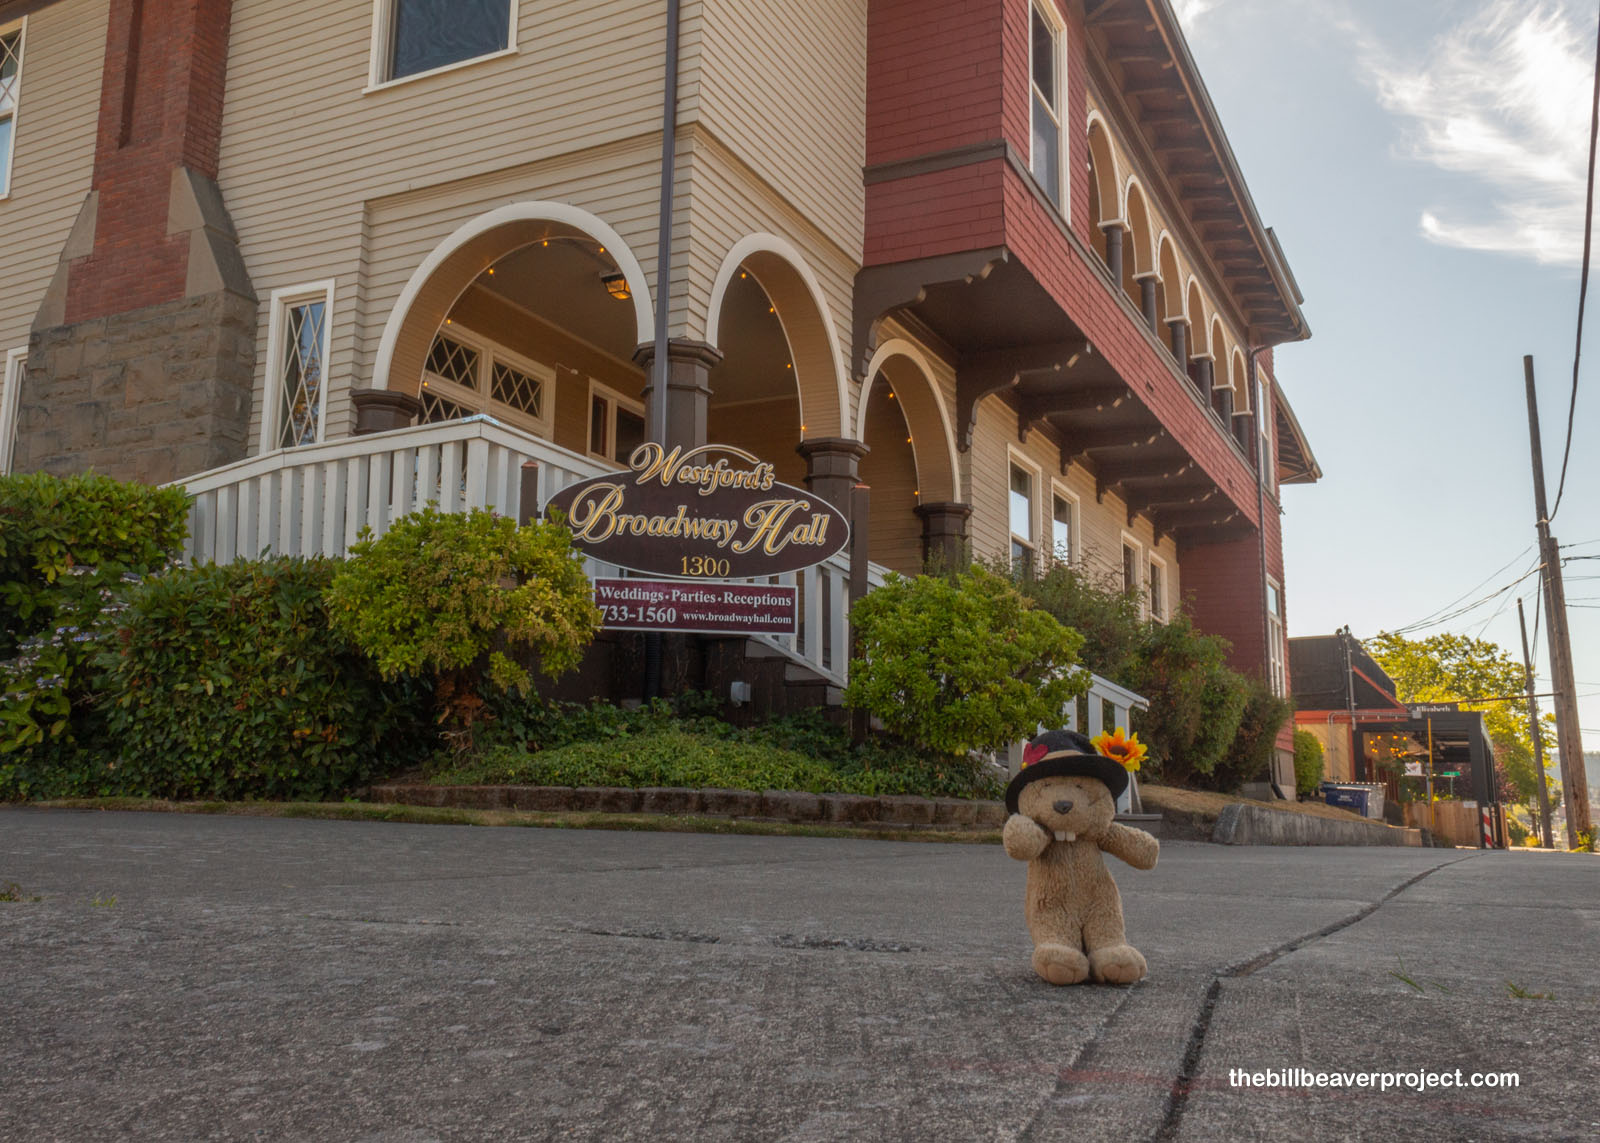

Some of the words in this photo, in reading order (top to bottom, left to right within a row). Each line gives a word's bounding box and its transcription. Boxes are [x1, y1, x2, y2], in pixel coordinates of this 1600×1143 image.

[629, 442, 776, 496] Westford's
[569, 482, 739, 548] Broadway
[731, 499, 831, 556] Hall
[680, 556, 731, 577] 1300
[599, 586, 664, 603] Weddings
[671, 589, 716, 604] Parties
[723, 591, 792, 608] Receptions
[599, 604, 677, 624] 733-1560
[683, 612, 792, 625] www.broadwayhall.com
